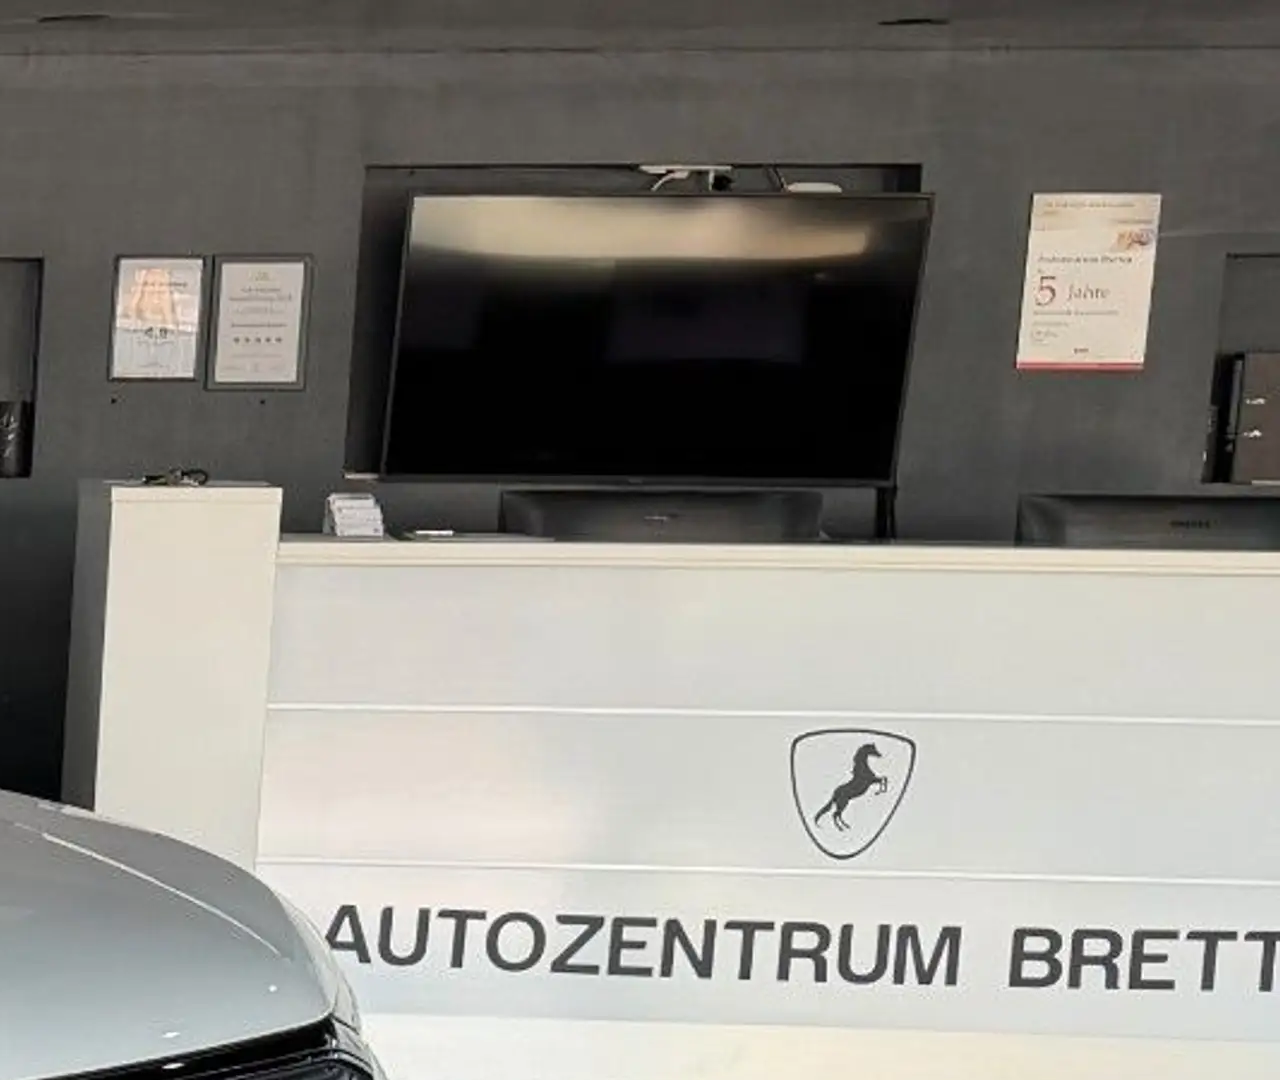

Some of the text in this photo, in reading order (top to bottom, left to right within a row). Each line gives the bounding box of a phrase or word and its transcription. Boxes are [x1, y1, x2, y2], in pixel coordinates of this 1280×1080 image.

[1035, 275, 1057, 307] 5
[325, 904, 1280, 992] AUTOZENTRUM BRETT
